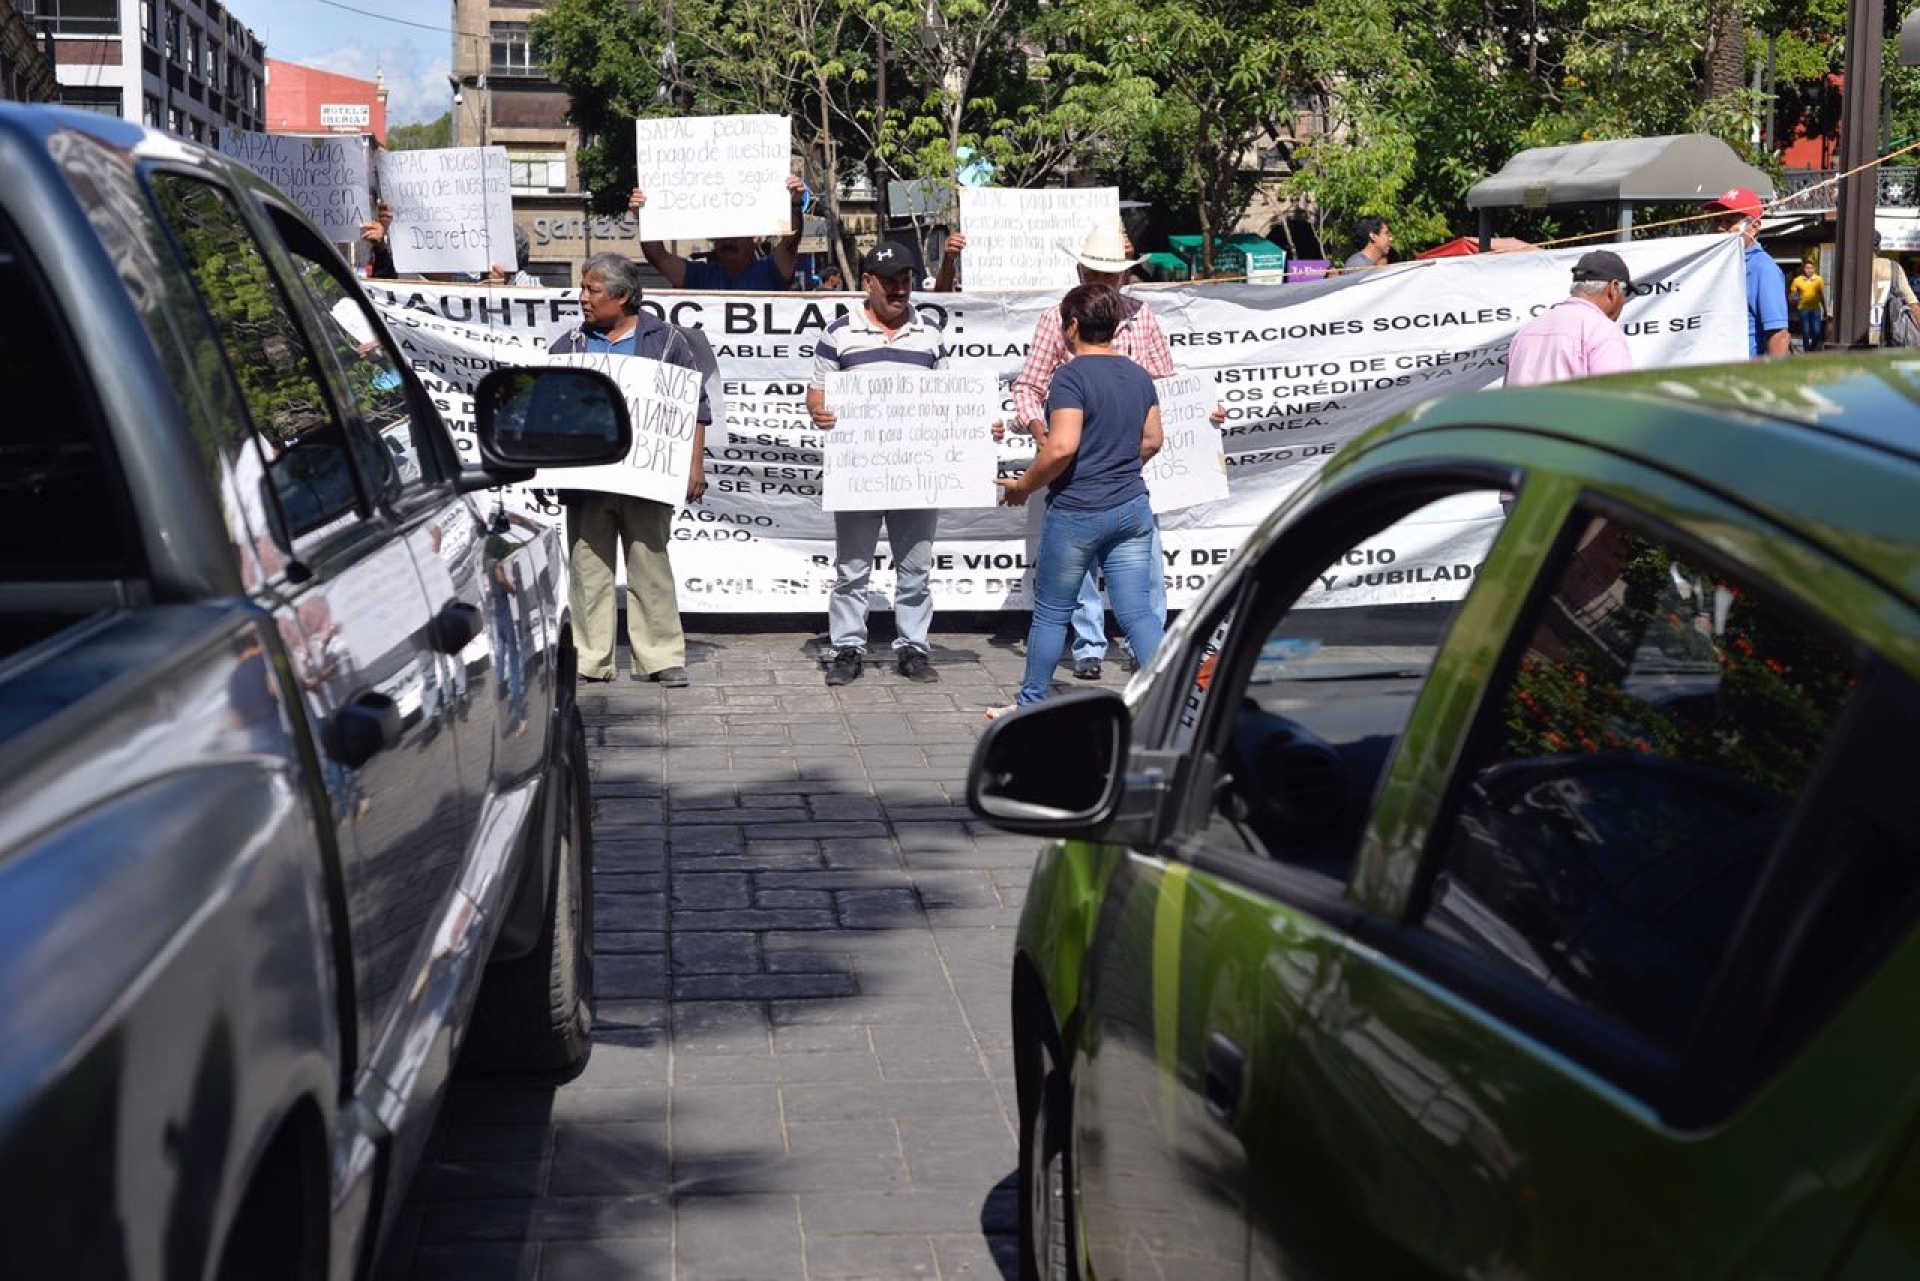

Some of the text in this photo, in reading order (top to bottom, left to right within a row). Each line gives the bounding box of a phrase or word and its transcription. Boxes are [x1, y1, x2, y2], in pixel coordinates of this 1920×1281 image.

[323, 107, 359, 115] HOTEL
[323, 116, 361, 124] IBERIA
[640, 119, 695, 142] SAPAC
[302, 143, 346, 170] paga
[638, 144, 652, 165] el
[657, 146, 696, 170] pago
[697, 140, 719, 163] de
[334, 166, 355, 185] de
[329, 188, 355, 206] en
[657, 187, 757, 211] Decretos
[410, 222, 492, 250] Decretos
[1168, 319, 1364, 348] RESTACIONES
[1374, 306, 1521, 332] SOCIALES,
[1349, 357, 1386, 375] DE
[1669, 311, 1703, 332] SE
[653, 363, 698, 404] NOS
[1273, 375, 1411, 400] CRÉDITOS
[1420, 368, 1453, 383] YA
[625, 395, 697, 442] ATANDO
[725, 416, 815, 431] ARCIAL
[1225, 400, 1348, 421] ORÁNEA.
[630, 432, 681, 478] BRE
[723, 447, 820, 464] OTORG
[1225, 450, 1294, 466] ARZO
[1302, 442, 1337, 458] DE
[1163, 427, 1195, 461] gún
[718, 479, 752, 493] SE
[670, 529, 759, 543] GADO.
[1337, 548, 1396, 566] CIO
[1320, 575, 1339, 592] Y
